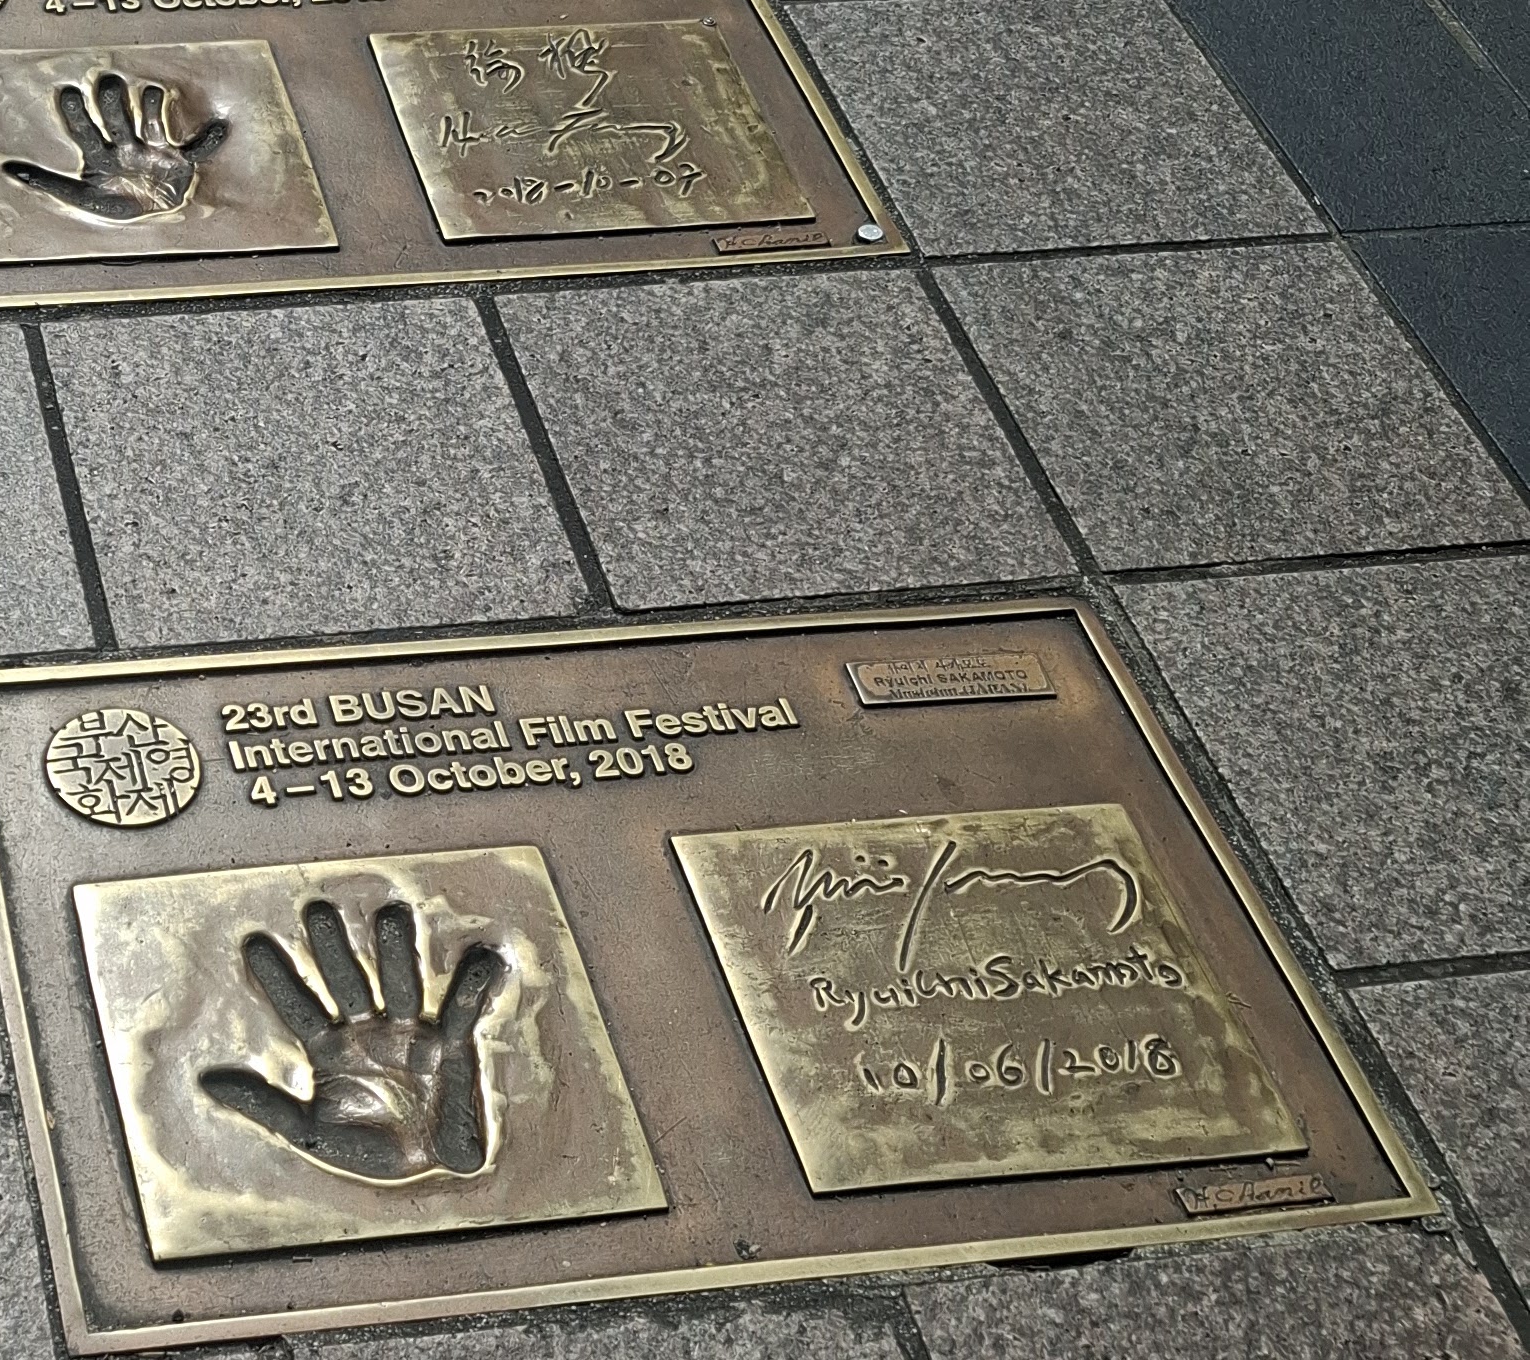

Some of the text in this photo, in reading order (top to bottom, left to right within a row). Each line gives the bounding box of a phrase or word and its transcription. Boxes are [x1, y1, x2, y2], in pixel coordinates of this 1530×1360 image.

[873, 668, 1029, 688] Ryuichi SAKAMOTO
[221, 684, 496, 733] 23rd BUSAN
[227, 697, 799, 772] International Film Festival
[388, 755, 583, 797] October,
[588, 743, 695, 780] 2018
